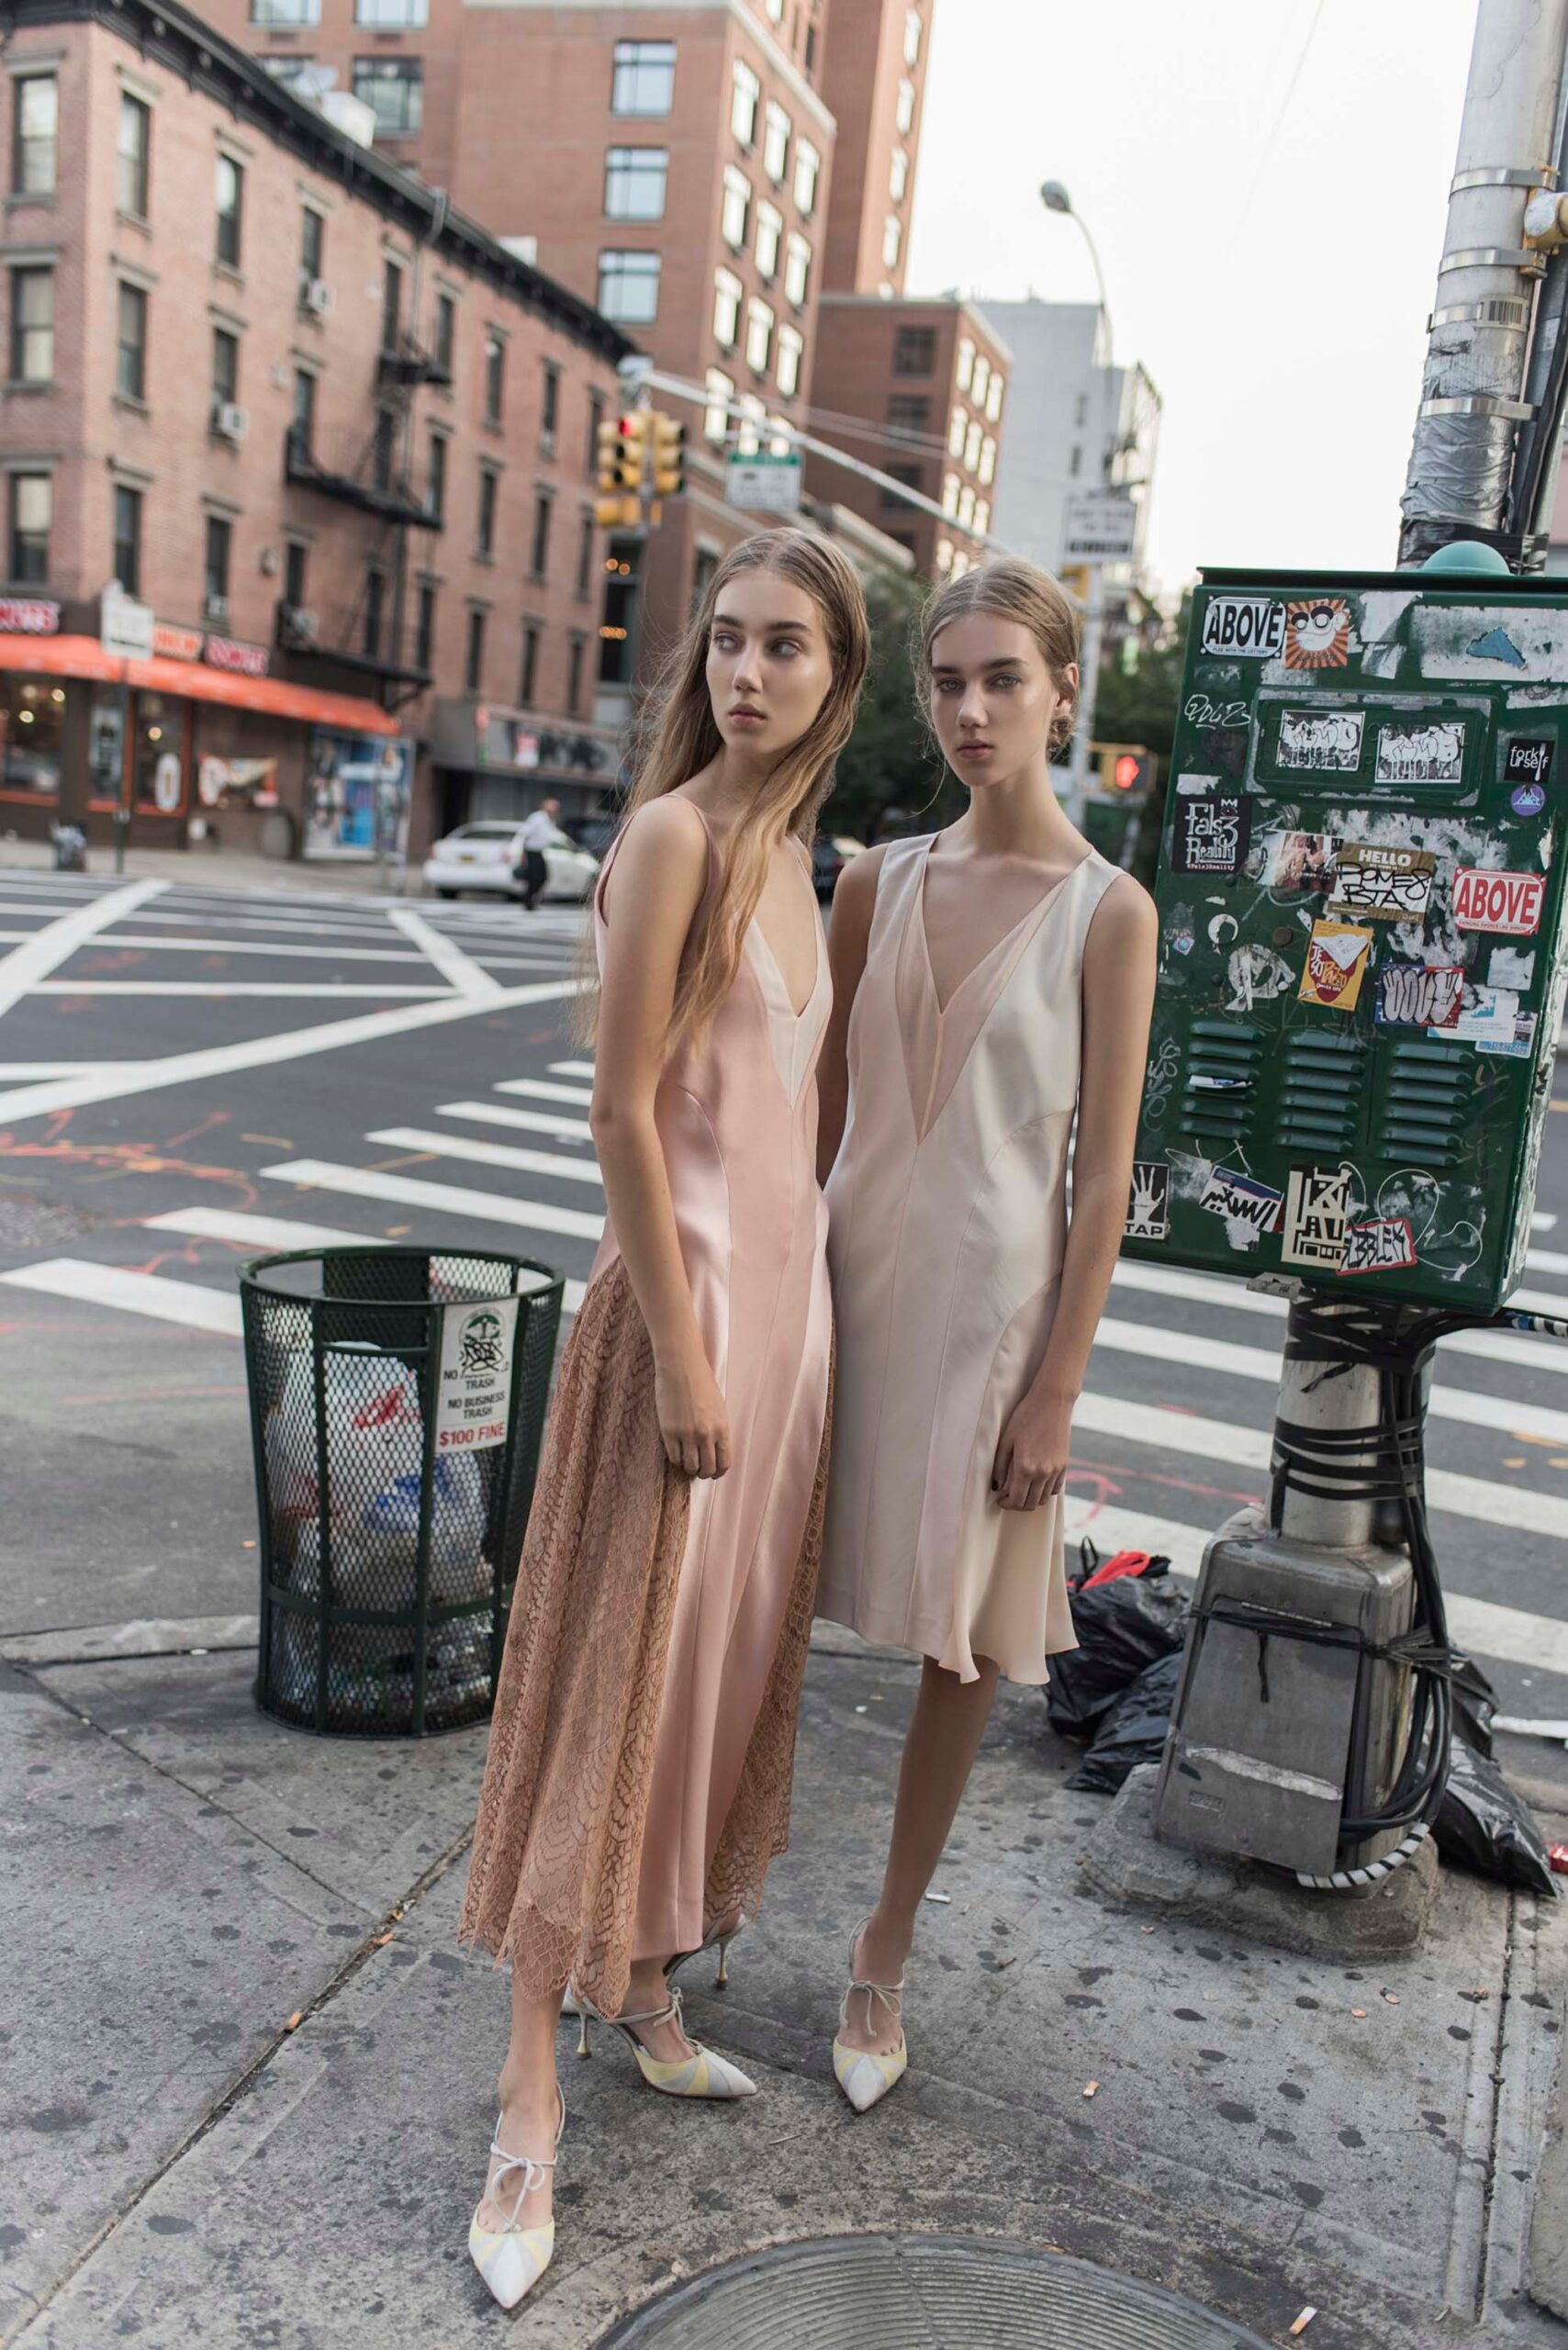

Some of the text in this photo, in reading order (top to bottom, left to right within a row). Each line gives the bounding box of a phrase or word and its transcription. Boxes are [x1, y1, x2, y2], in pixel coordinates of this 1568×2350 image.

[1205, 604, 1282, 647] ABOVE
[1510, 745, 1539, 761] fork
[1185, 837, 1237, 864] Reality
[1359, 849, 1412, 867] HELLO
[1455, 877, 1540, 924] ABOVE
[1126, 1223, 1163, 1236] TAP
[443, 1370, 458, 1380] NO
[465, 1378, 495, 1390] TRASH
[447, 1391, 505, 1409] NO BUSINESS
[463, 1406, 493, 1419] TRASH
[440, 1422, 505, 1446] $100 FINE
